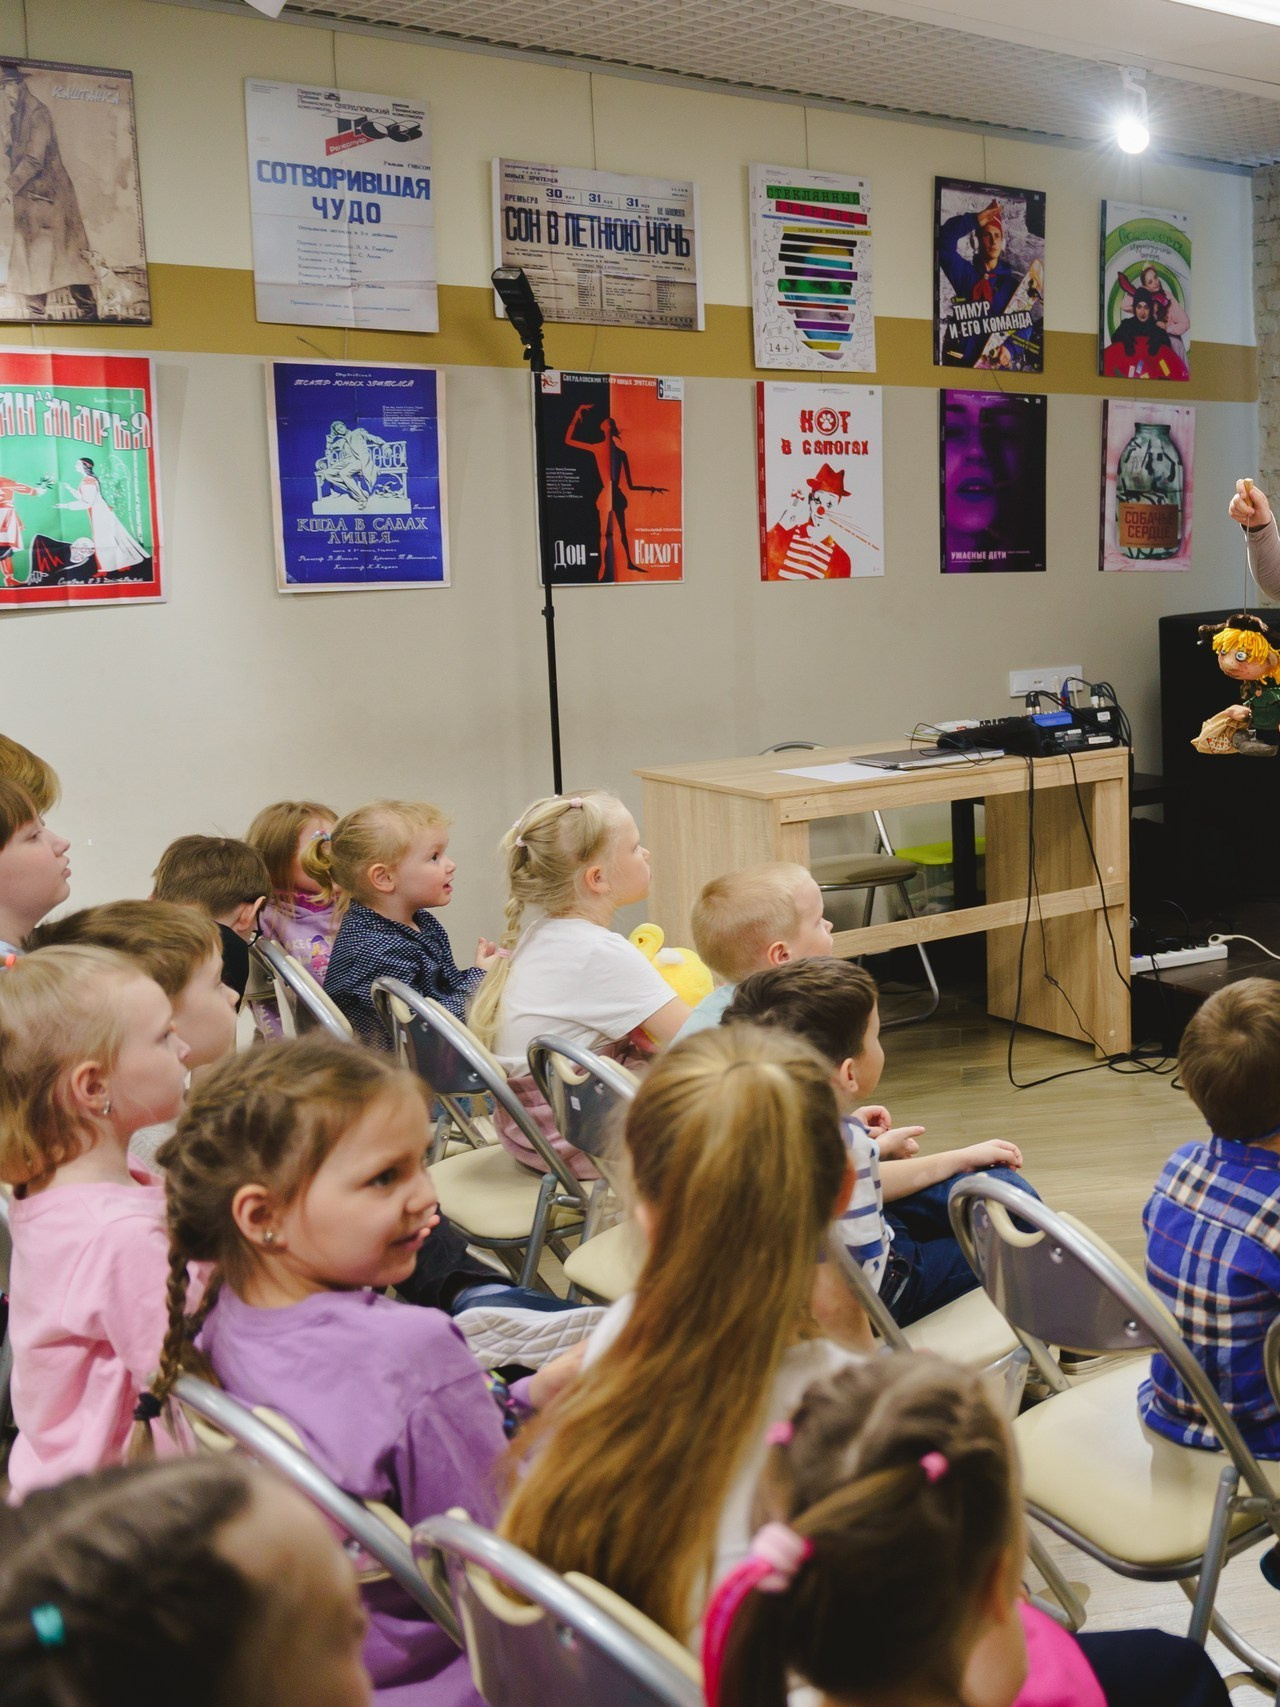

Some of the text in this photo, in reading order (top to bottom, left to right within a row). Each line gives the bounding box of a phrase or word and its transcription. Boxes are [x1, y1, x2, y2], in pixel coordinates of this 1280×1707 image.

[52, 85, 121, 105] КАШТАНКА
[335, 102, 390, 115] СВЕРДЛОВСКИЙ
[257, 160, 431, 200] СОТВОРИВШАЯ
[504, 193, 539, 204] ПРЕМЬЕРА
[546, 188, 563, 199] 30
[588, 193, 601, 203] 31
[767, 187, 860, 205] СТЕКЛЯННЫЙ
[312, 196, 382, 225] ЧУДО
[626, 197, 639, 208] 31
[504, 206, 691, 258] СОН В ЛЕТНЮЮ НОЧЬ
[953, 301, 990, 320] ТИМУР
[949, 311, 1033, 339] И ЕГО КОМАНДА
[769, 342, 789, 352] 14+
[332, 379, 364, 387] ЮНЫХ
[366, 379, 414, 387] ЗРИТЕЛЕЙ
[659, 379, 664, 398] 6
[44, 397, 152, 450] МАРЬЯ
[799, 407, 851, 436] КОТ
[297, 517, 428, 532] КОГДА В САДАХ
[1125, 511, 1174, 525] СОБАЧЬЕ
[1128, 525, 1170, 541] СЕРДЦЕ
[951, 551, 1007, 560] УЖАСНЫЕ ДЕТИ
